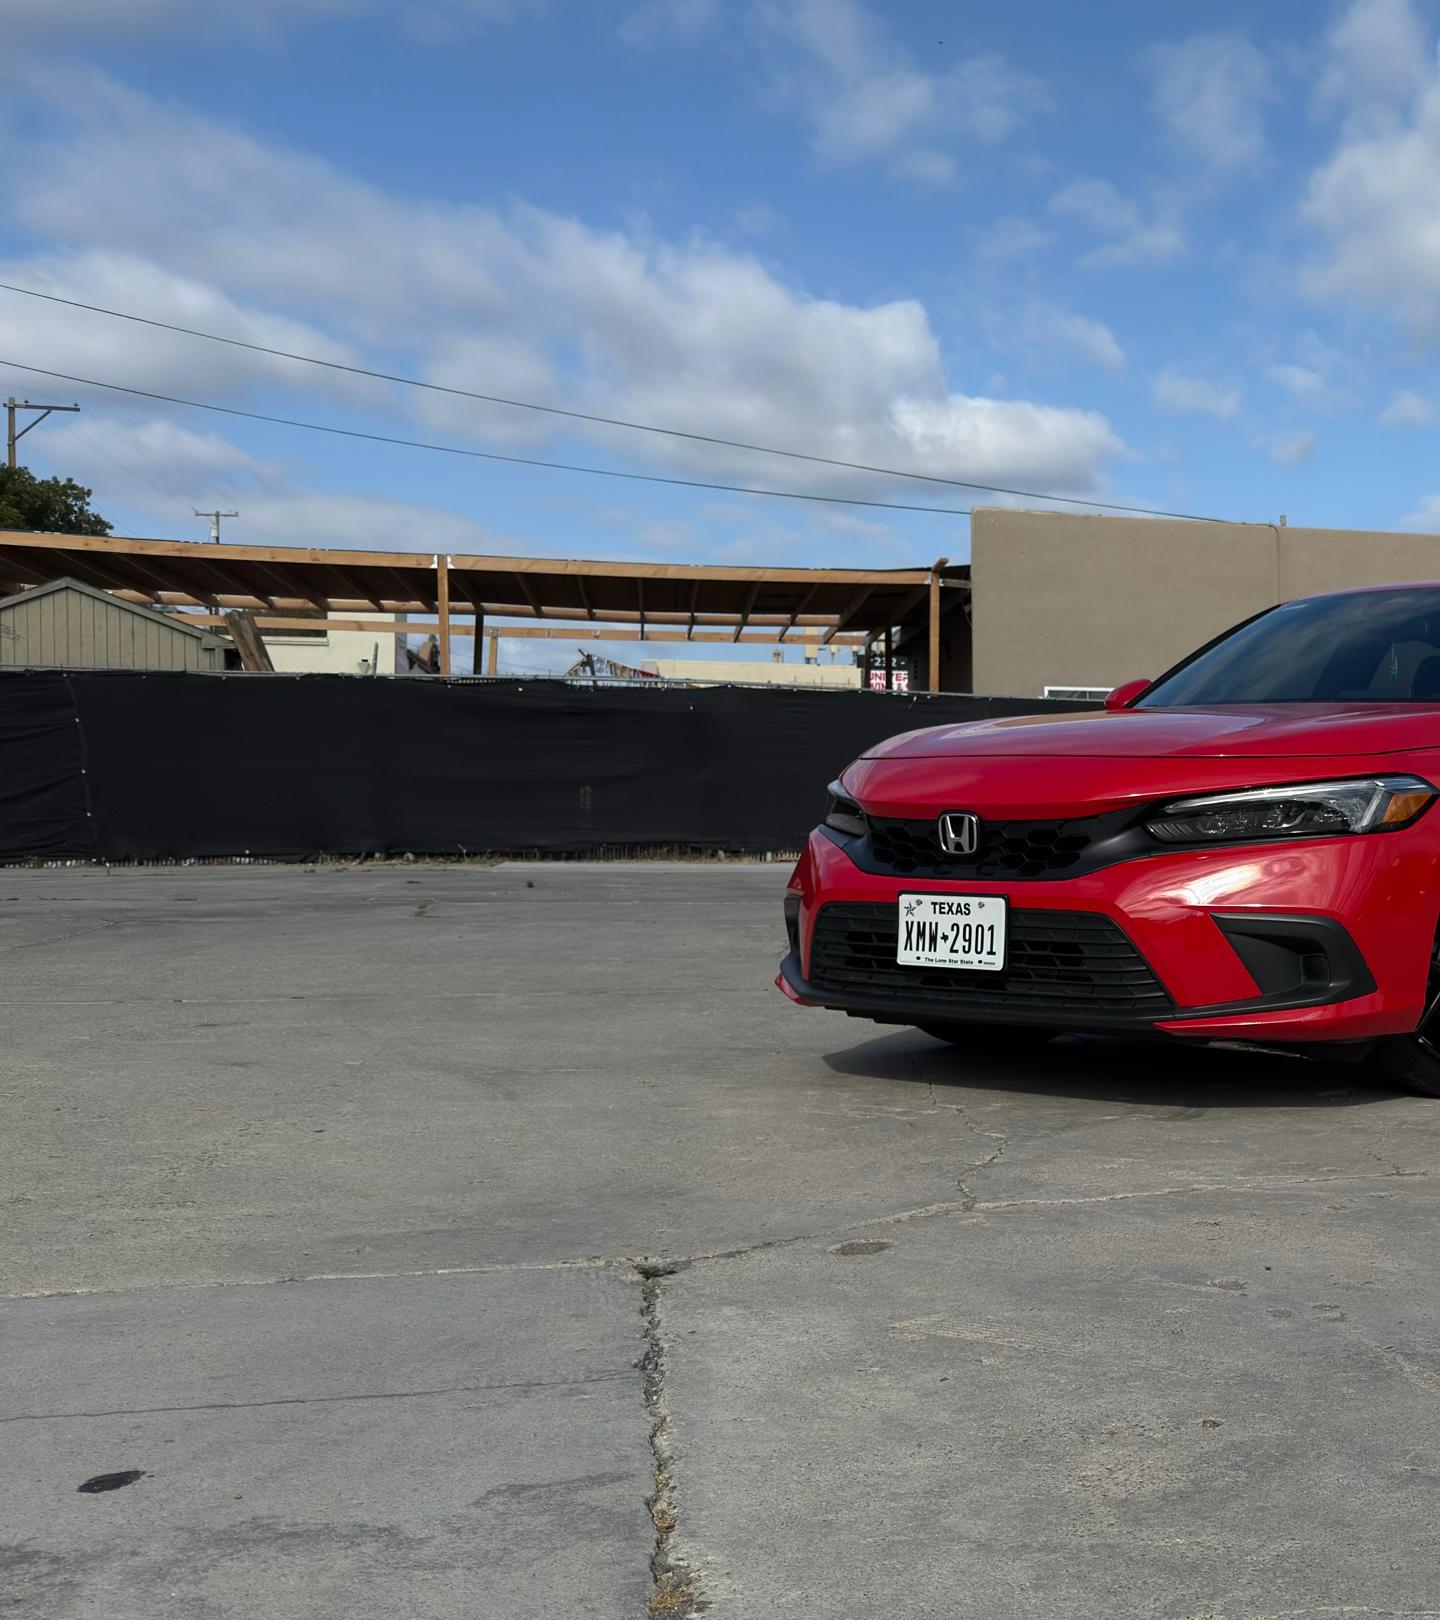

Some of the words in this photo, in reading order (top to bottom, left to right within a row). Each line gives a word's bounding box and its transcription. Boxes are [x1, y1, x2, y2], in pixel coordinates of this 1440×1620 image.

[931, 901, 971, 915] TEXAS
[904, 920, 938, 952] XMW
[950, 923, 996, 955] 2901
